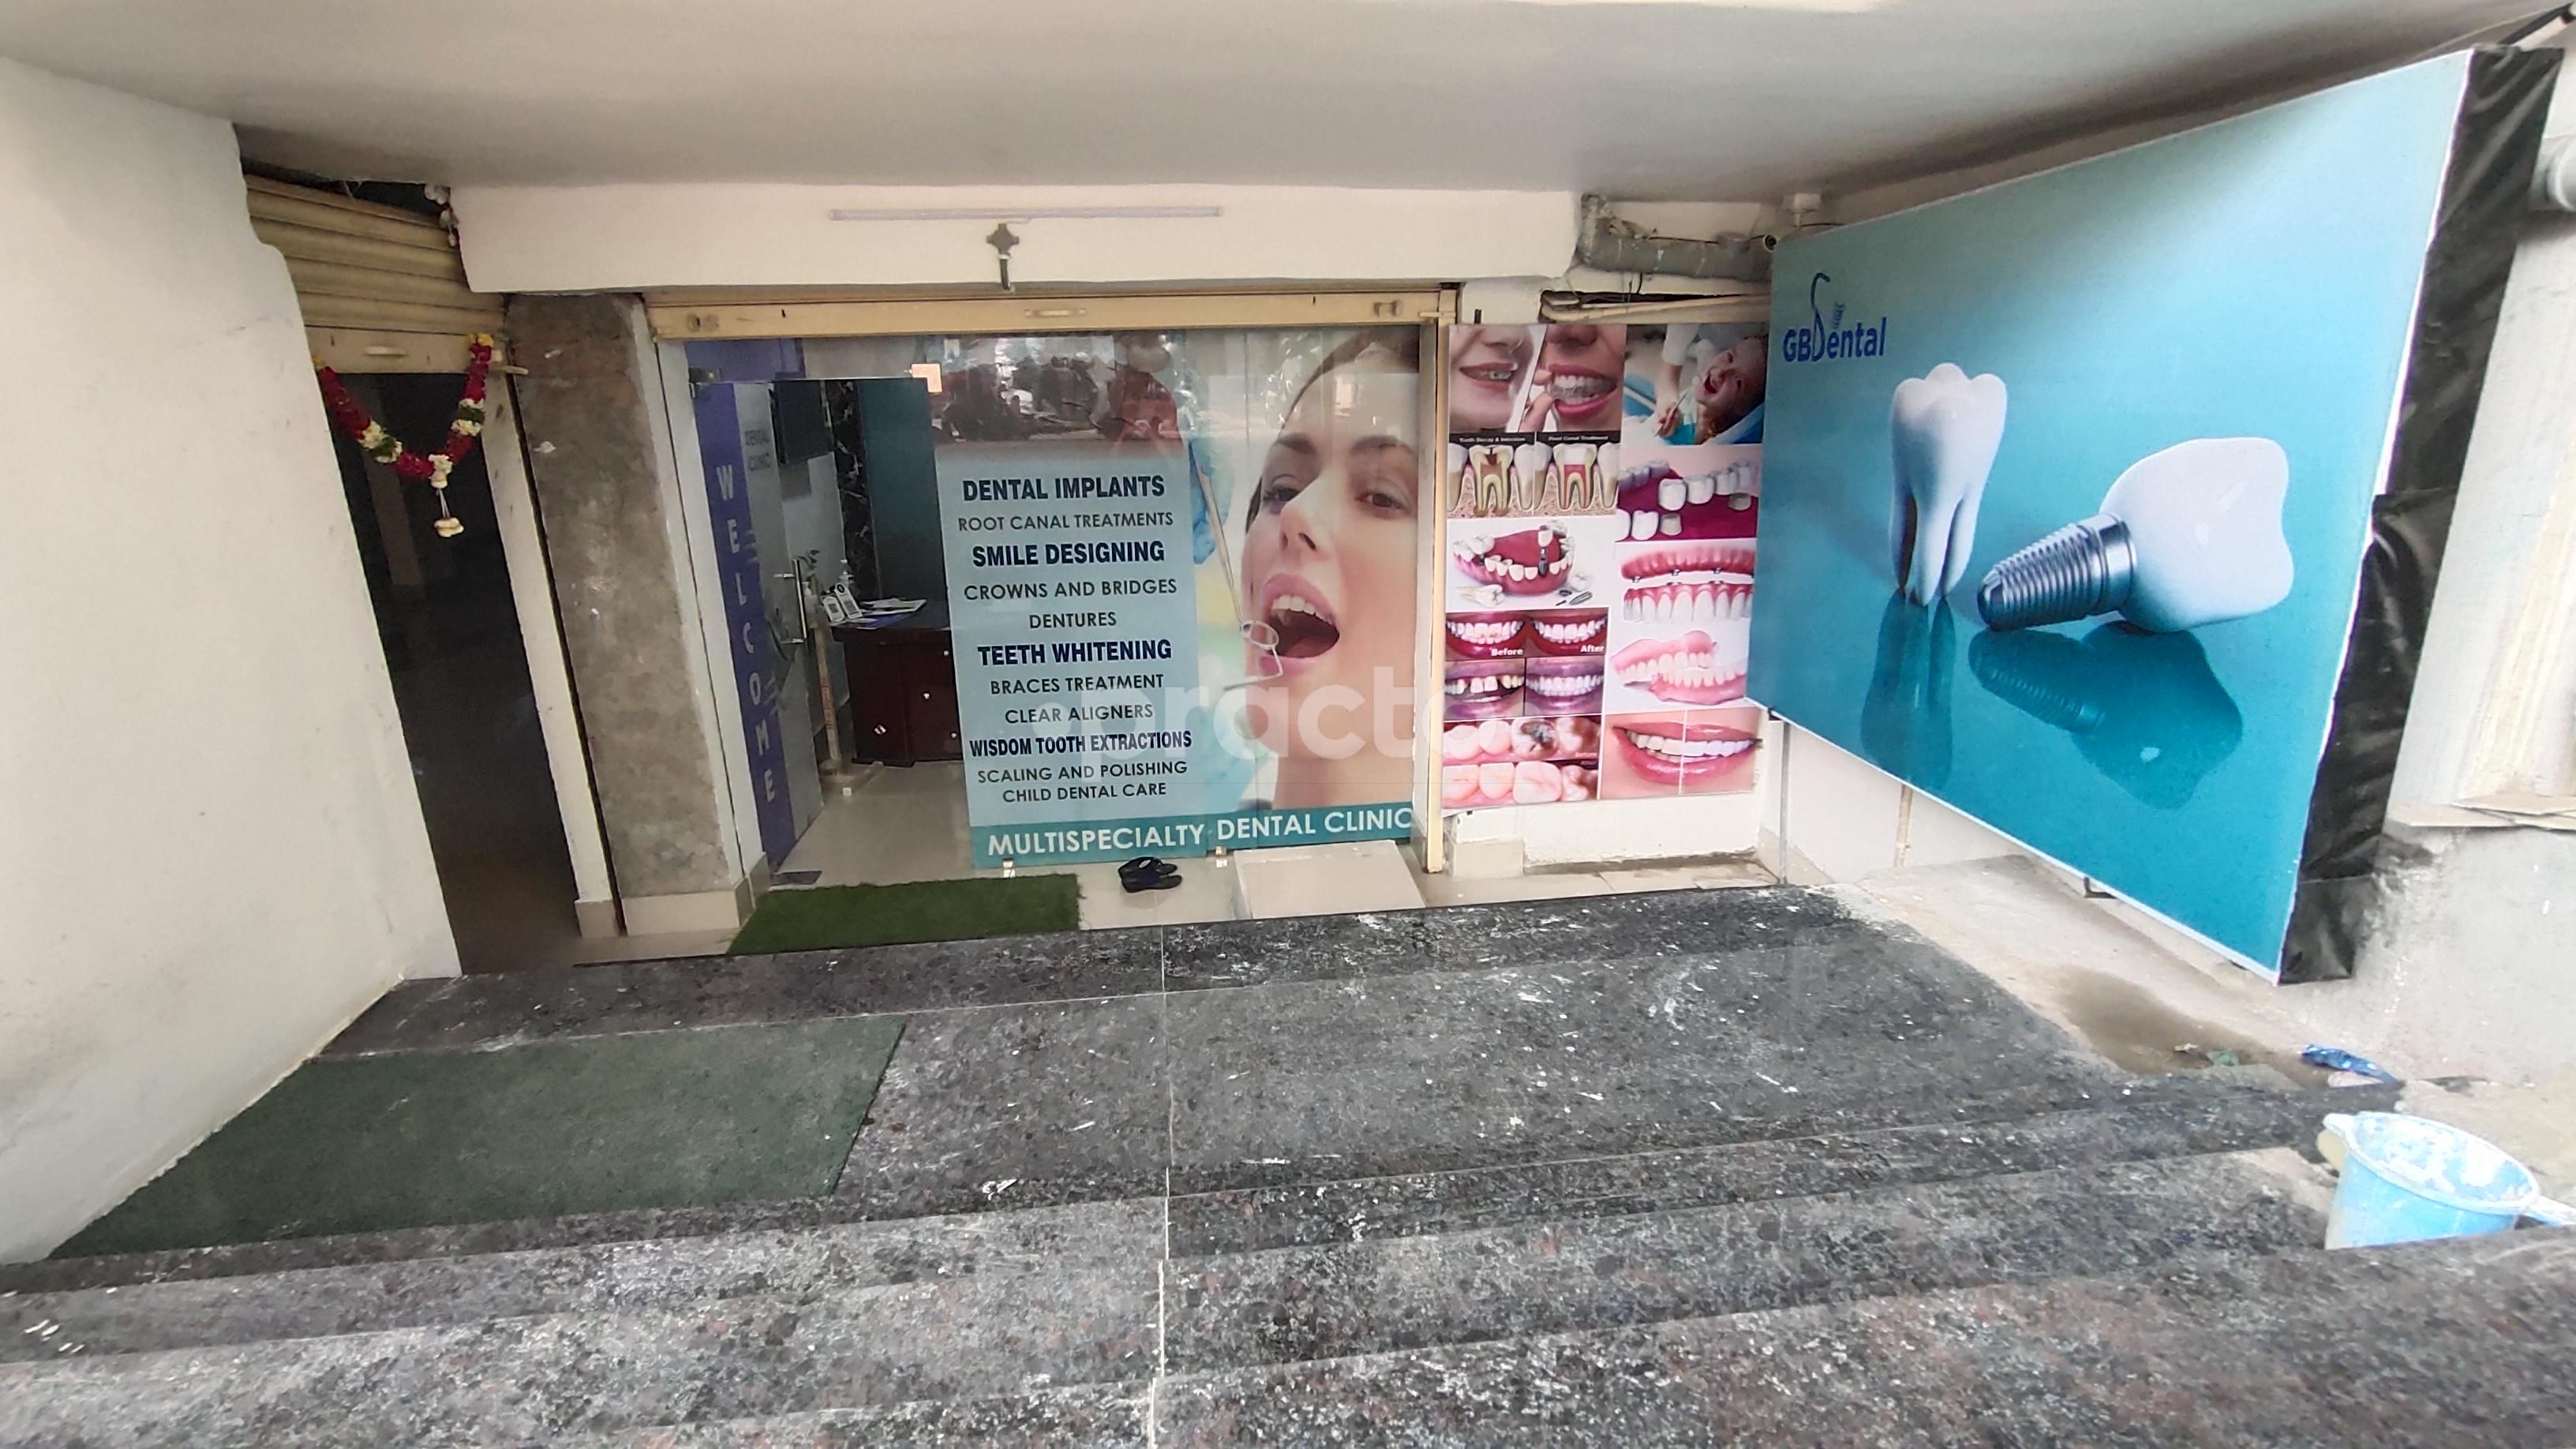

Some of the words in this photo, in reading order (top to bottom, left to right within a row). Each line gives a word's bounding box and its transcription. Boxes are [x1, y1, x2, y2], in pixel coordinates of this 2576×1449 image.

[963, 478, 1048, 501] DENTAL
[1055, 475, 1165, 499] IMPLANTS
[958, 517, 1005, 531] ROOT
[1010, 515, 1069, 530] CANAL
[1074, 512, 1174, 528] TREATMENTS
[972, 545, 1038, 567] SMILE
[1046, 541, 1165, 564] DESIGNING
[964, 583, 1048, 601] CROWNS
[1054, 582, 1095, 597] AND
[1102, 578, 1177, 596] BRIDGES
[1029, 612, 1117, 629] DENTURES
[716, 464, 775, 802] WELCOME
[978, 644, 1045, 666] TEETH
[1051, 638, 1172, 663] WHITENING
[990, 678, 1060, 695] BRACES
[1065, 674, 1164, 692] TREATMENT
[1005, 710, 1061, 724] CLEAR
[1068, 704, 1154, 721] ALIGNERS
[970, 738, 1032, 757] WISDOM
[1035, 735, 1086, 754] TOOTH
[1091, 730, 1193, 751] EXTRACTIONS
[978, 767, 1052, 783] SCALING
[1058, 766, 1094, 780] AND
[1101, 761, 1188, 777] POLISHING
[1002, 789, 1051, 803] CHILD
[1058, 785, 1118, 800] DENTAL
[1122, 782, 1166, 797] CARE
[987, 823, 1205, 856] MULTISPECIALTY
[1217, 814, 1316, 841] DENTAL
[1324, 807, 1412, 833] CLINIC
